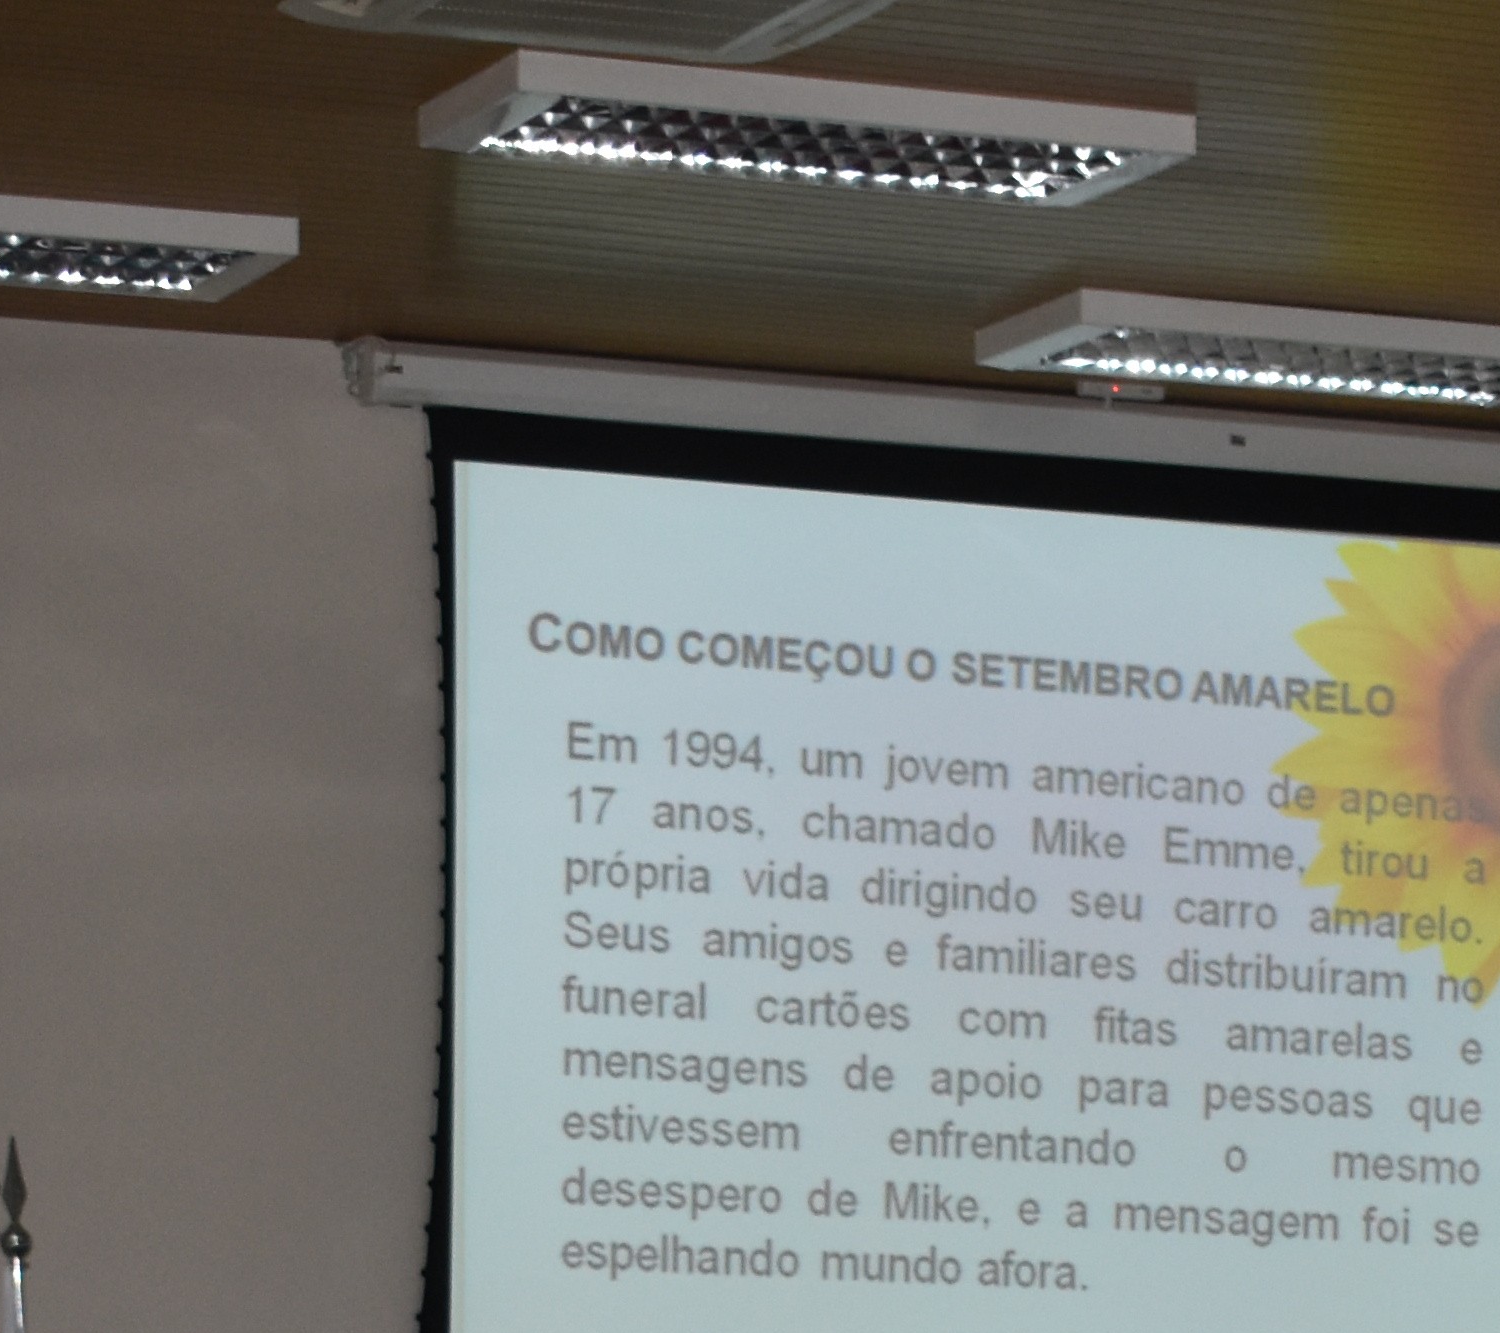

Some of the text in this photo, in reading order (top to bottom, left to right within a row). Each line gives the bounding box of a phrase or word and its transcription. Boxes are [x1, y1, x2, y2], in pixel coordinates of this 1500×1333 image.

[677, 629, 895, 683] COMEÇOU
[905, 647, 937, 683] O
[951, 650, 1184, 702] SETEMBRO
[1191, 670, 1396, 718] AMARELO
[566, 719, 1486, 825] Em 1994, um jovem americano de apenas
[567, 785, 1487, 886] 17 anos, chamado Mike Emme, tirou a
[564, 850, 1483, 945] própria vida dirigindo seu carro amarelo.
[563, 909, 1486, 1005] Seus amigos e familiares distribuíram no
[560, 973, 1484, 1066] funeral cartões com fitas amarelas e
[562, 1047, 1483, 1133] mensagens de apoio para pessoas que
[561, 1103, 1481, 1187] estivessem enfrentando o mesmo
[560, 1166, 1481, 1248] desespero de Mike, e a mensagem foi se
[559, 1233, 1089, 1292] espelhando mundo afora.
